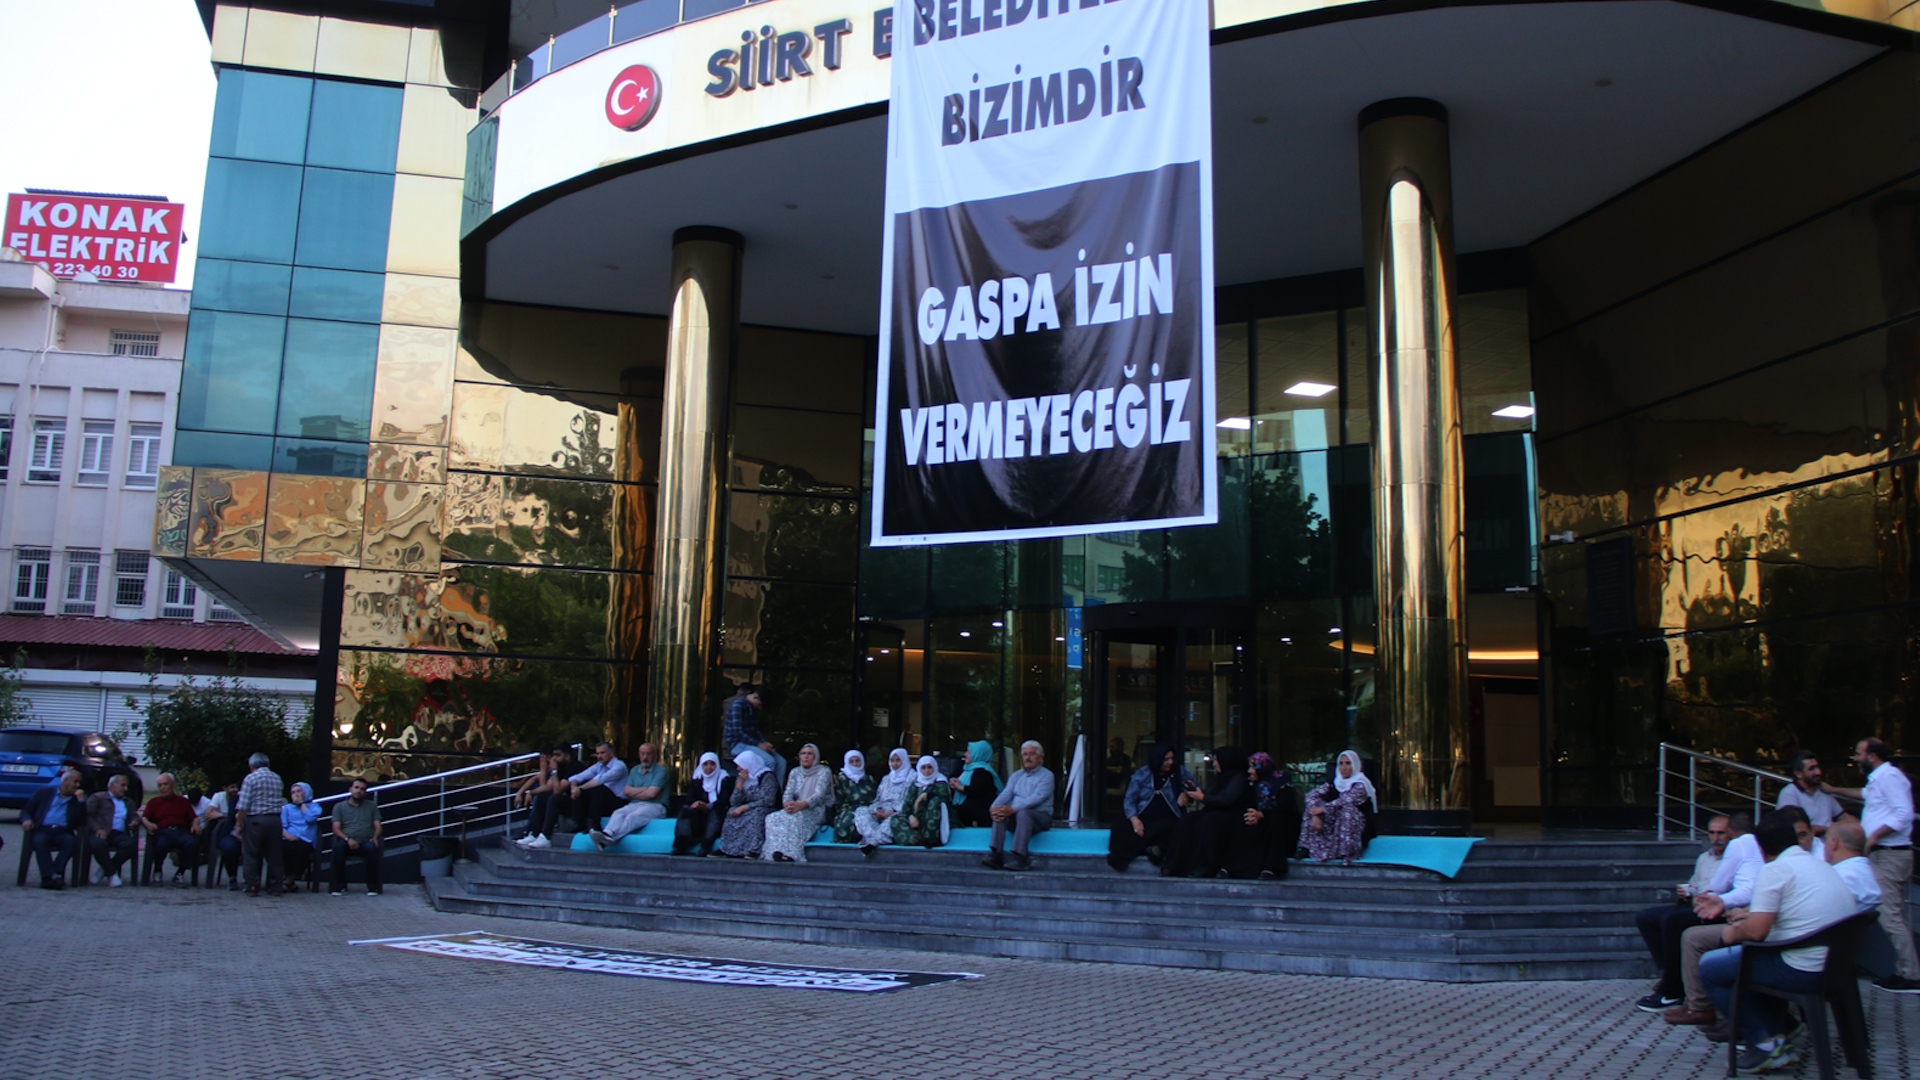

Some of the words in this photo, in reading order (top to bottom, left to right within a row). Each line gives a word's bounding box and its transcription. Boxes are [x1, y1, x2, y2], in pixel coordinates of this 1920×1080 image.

[941, 44, 1147, 147] BİZİMDİR
[19, 200, 170, 234] KONAK
[53, 262, 85, 276] 223
[90, 265, 112, 277] 40
[116, 267, 139, 279] 30
[917, 272, 1060, 346] GASPA
[1074, 241, 1174, 327] İZİN
[900, 362, 1191, 466] VERMEYECEĞİZ
